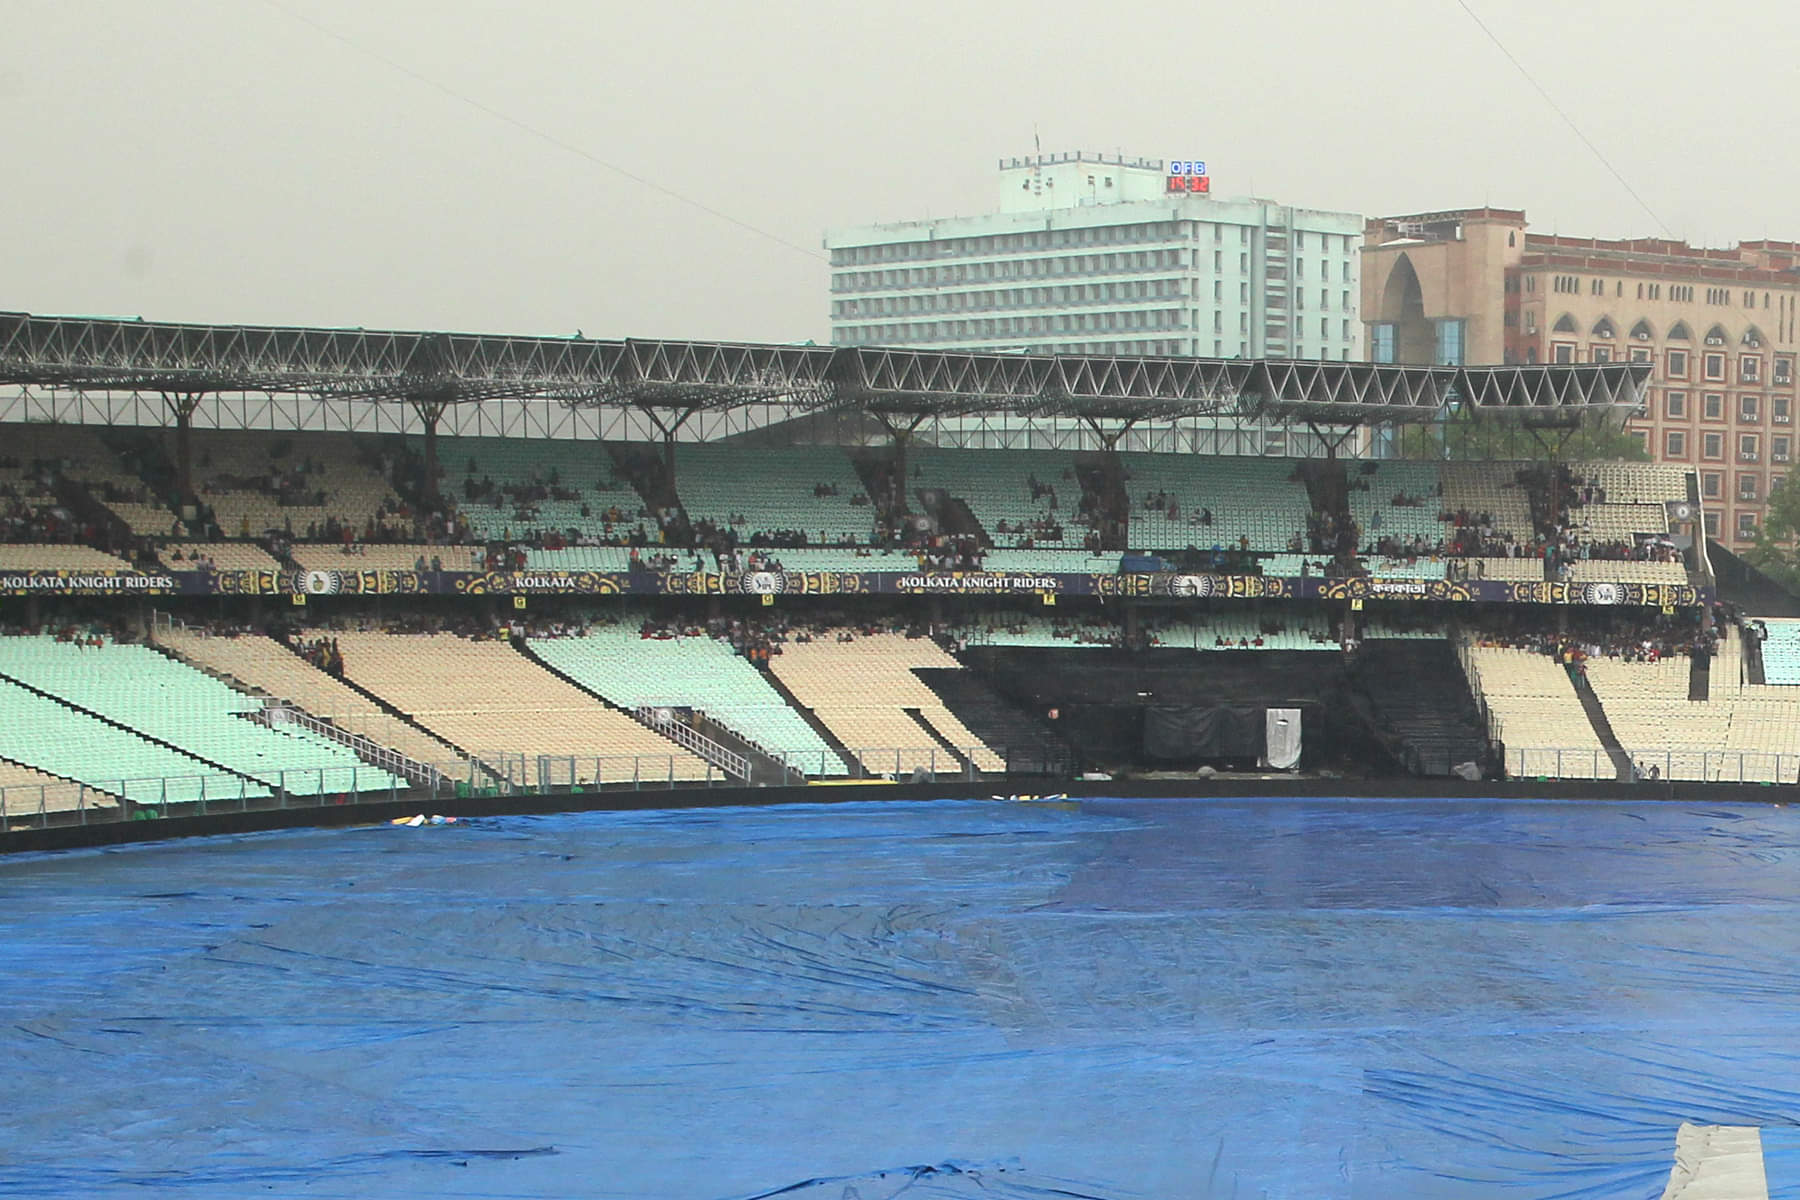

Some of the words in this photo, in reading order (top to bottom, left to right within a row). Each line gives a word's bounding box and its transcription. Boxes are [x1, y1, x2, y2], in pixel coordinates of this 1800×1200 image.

[3, 577, 65, 588] KOLKATA
[69, 577, 122, 588] KNIGHT
[125, 577, 173, 588] RIDERS
[516, 577, 576, 588] KOLKATA
[901, 577, 959, 588] KOLKATA
[962, 577, 1010, 588] KNIGHT
[1013, 577, 1057, 588] RIDERS
